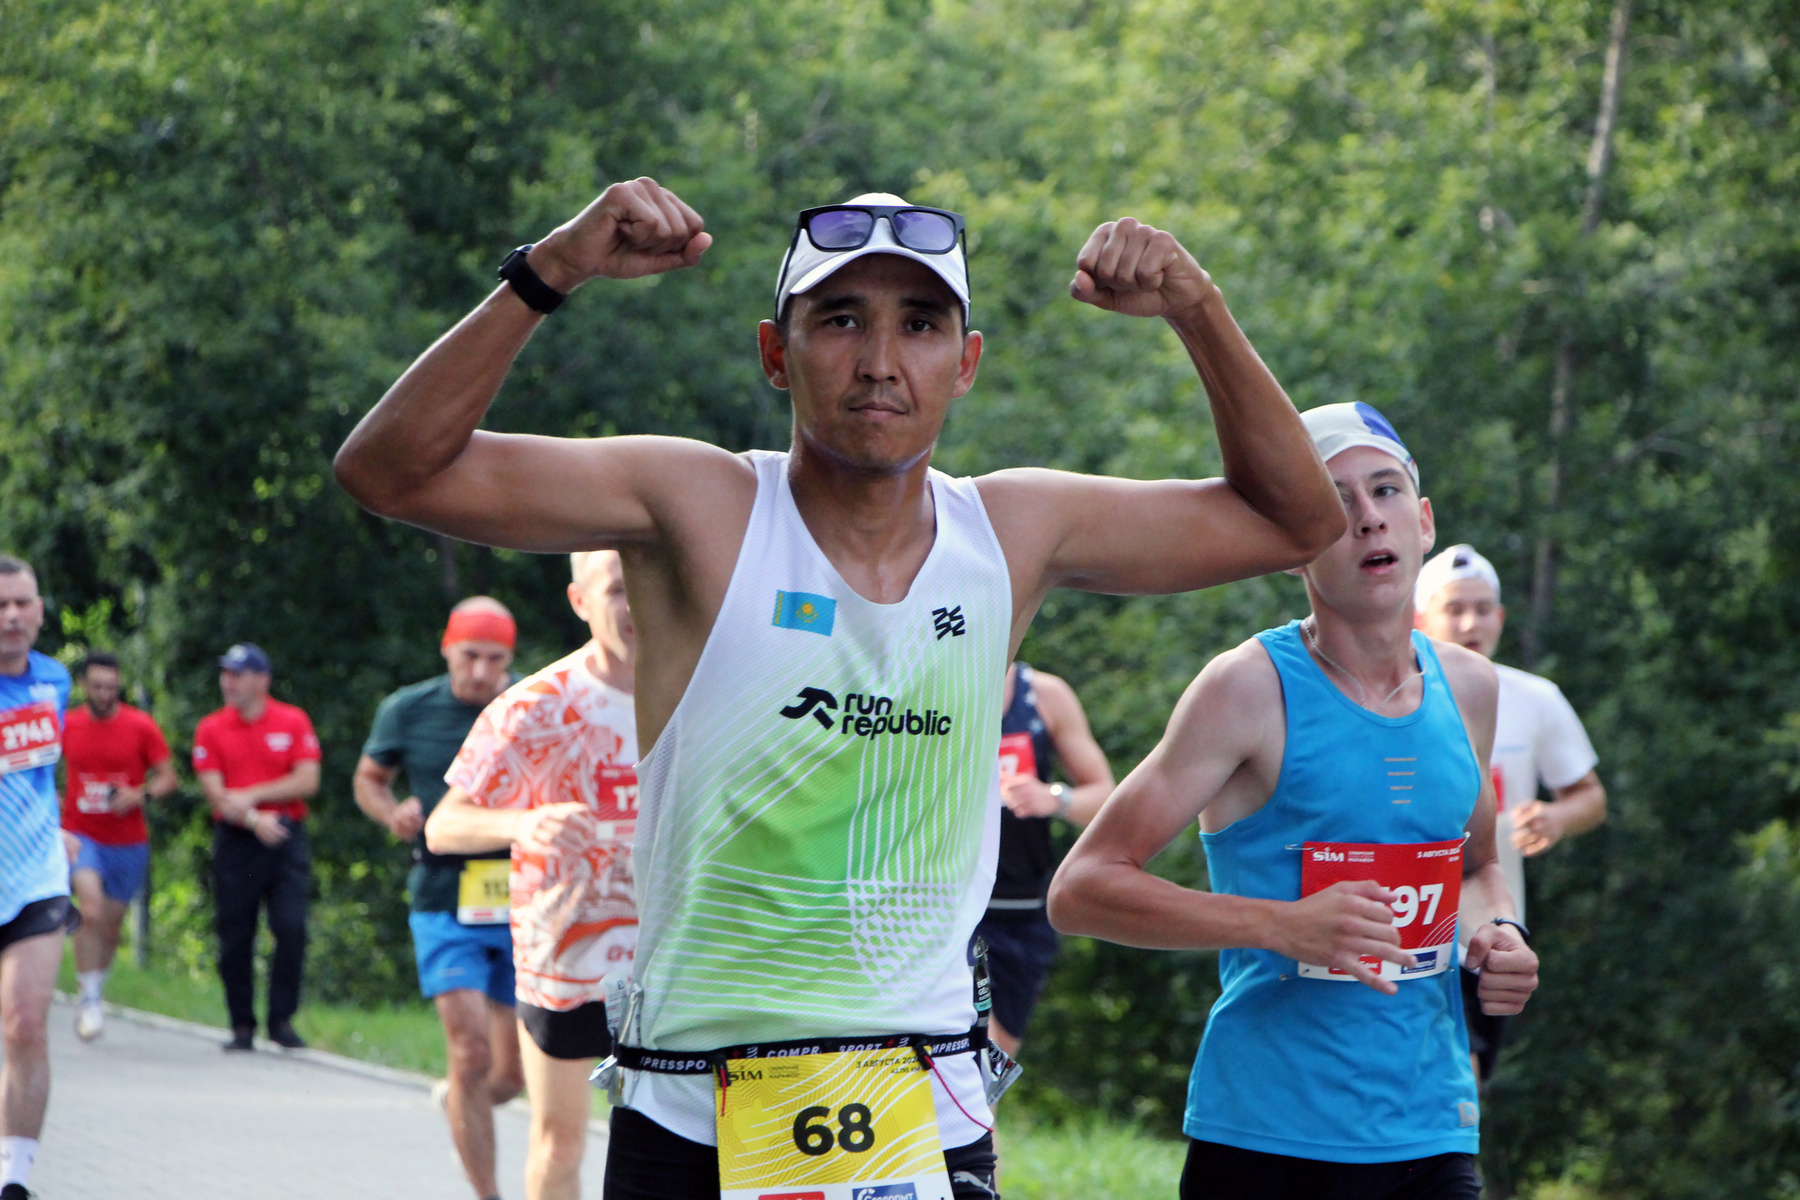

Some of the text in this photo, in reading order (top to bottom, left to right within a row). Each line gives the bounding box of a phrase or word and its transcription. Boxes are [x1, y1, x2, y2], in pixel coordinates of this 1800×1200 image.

[844, 693, 893, 716] run
[841, 709, 952, 741] republic
[1380, 884, 1444, 928] 97
[793, 1102, 875, 1156] 68
